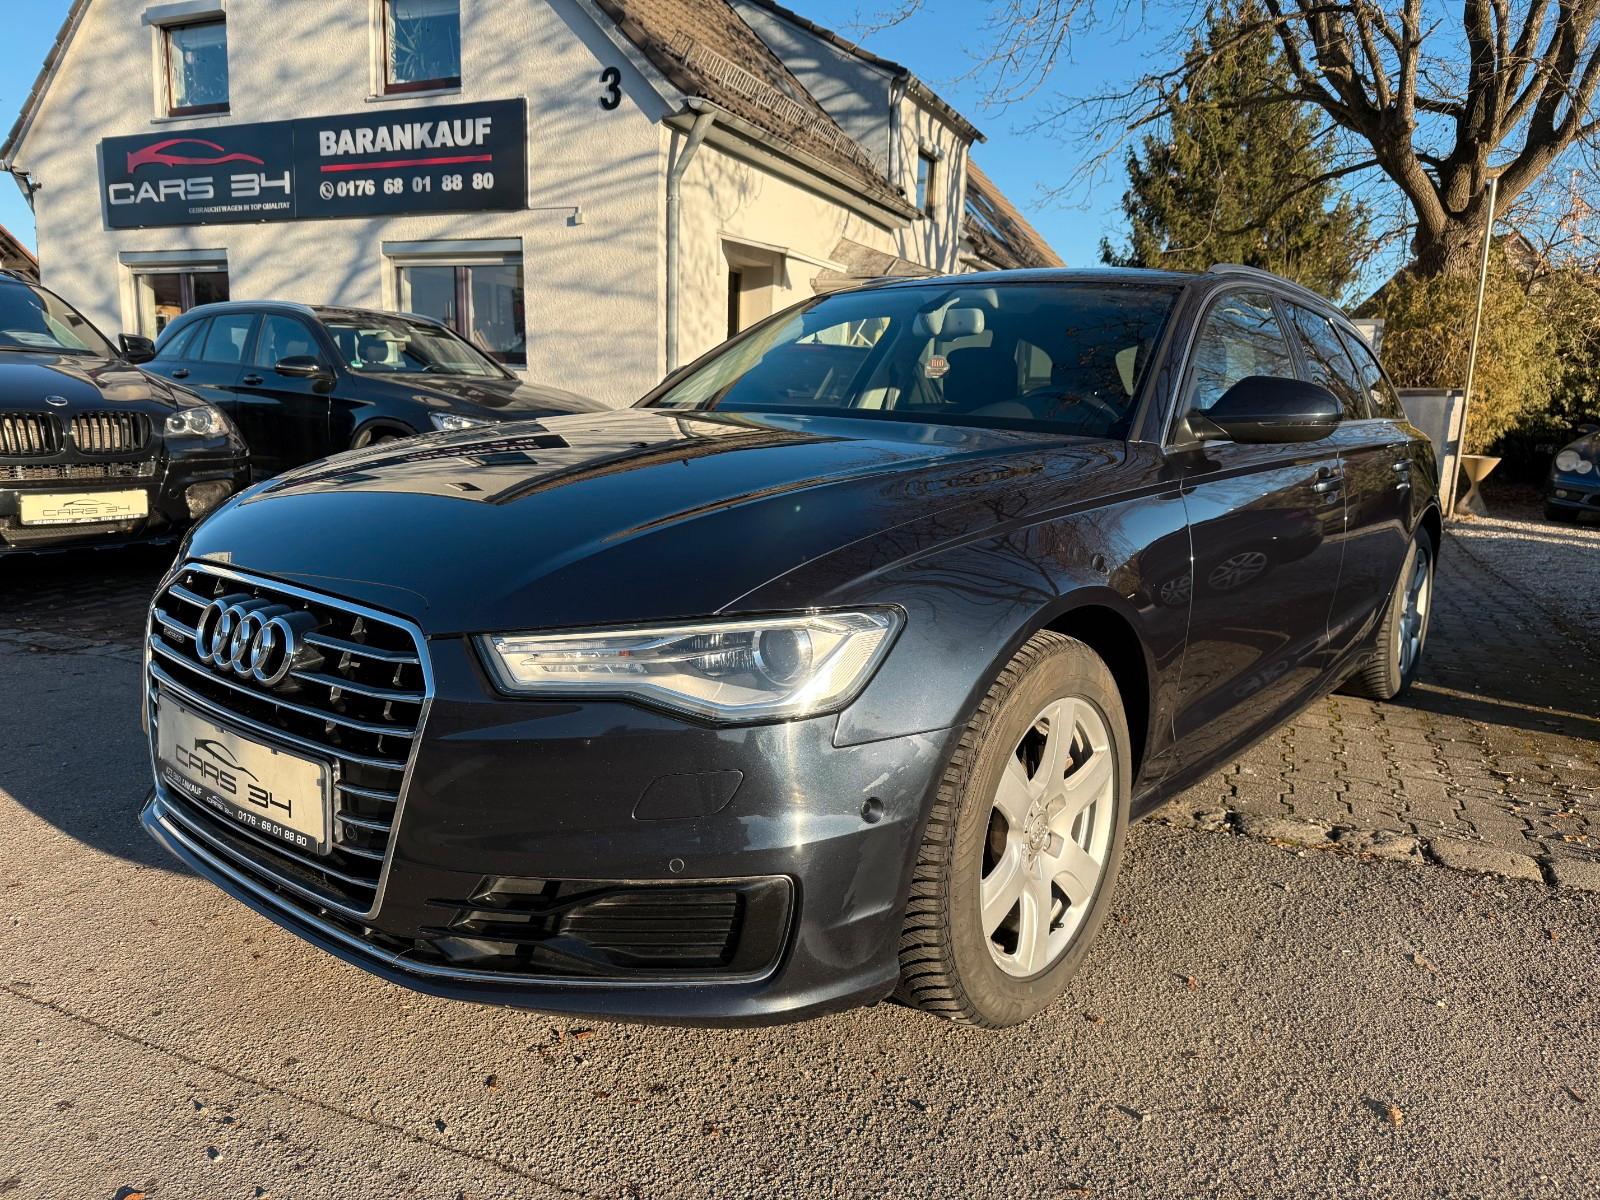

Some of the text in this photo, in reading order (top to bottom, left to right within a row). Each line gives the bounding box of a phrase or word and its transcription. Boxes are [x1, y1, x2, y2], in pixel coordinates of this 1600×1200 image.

[600, 66, 621, 110] 3
[319, 117, 492, 156] BARANKAUF
[108, 171, 290, 205] CARS 34
[337, 172, 494, 197] 0176 68 01 88 80
[250, 203, 261, 211] TOP
[43, 505, 130, 517] CARS 34
[175, 744, 237, 794] CARS
[248, 783, 292, 818] 34
[238, 810, 256, 825] 0176
[261, 820, 272, 832] 68
[272, 825, 282, 837] 01
[284, 830, 295, 841] 88
[296, 835, 307, 847] 80
